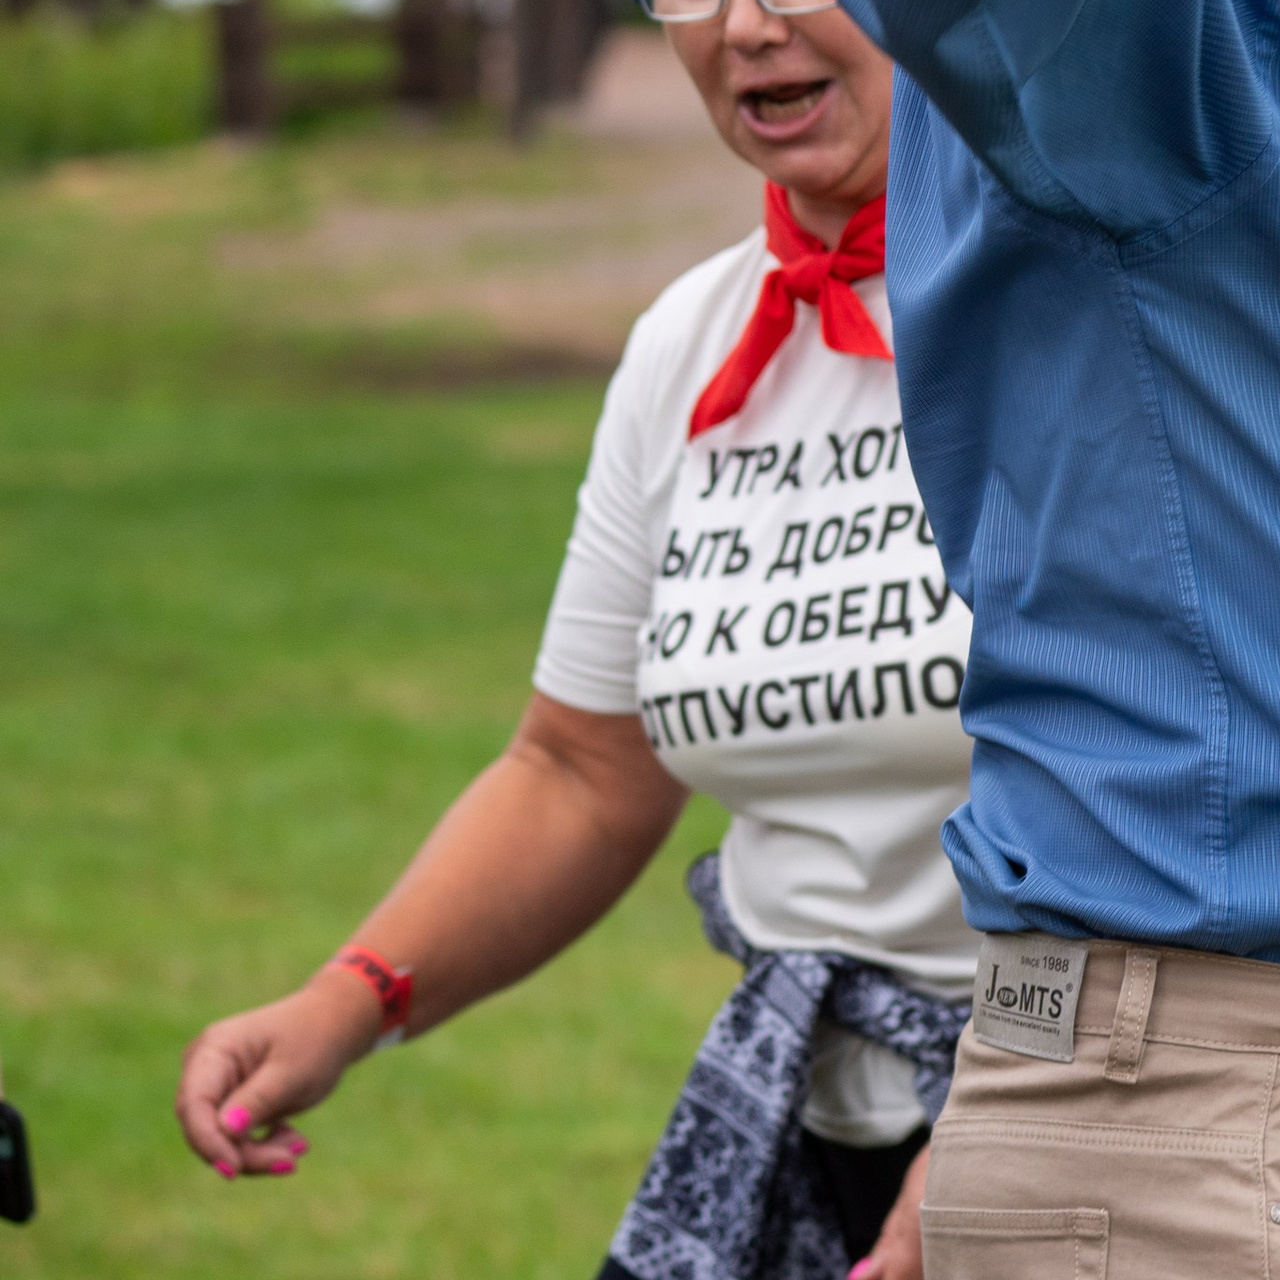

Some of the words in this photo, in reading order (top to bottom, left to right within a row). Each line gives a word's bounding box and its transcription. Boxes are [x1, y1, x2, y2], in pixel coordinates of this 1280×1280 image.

[699, 440, 804, 498] УТРА
[660, 528, 752, 581] ЫТЬ
[706, 605, 750, 656] К
[763, 576, 952, 643] ОБЕДУ
[1042, 955, 1069, 973] 1988
